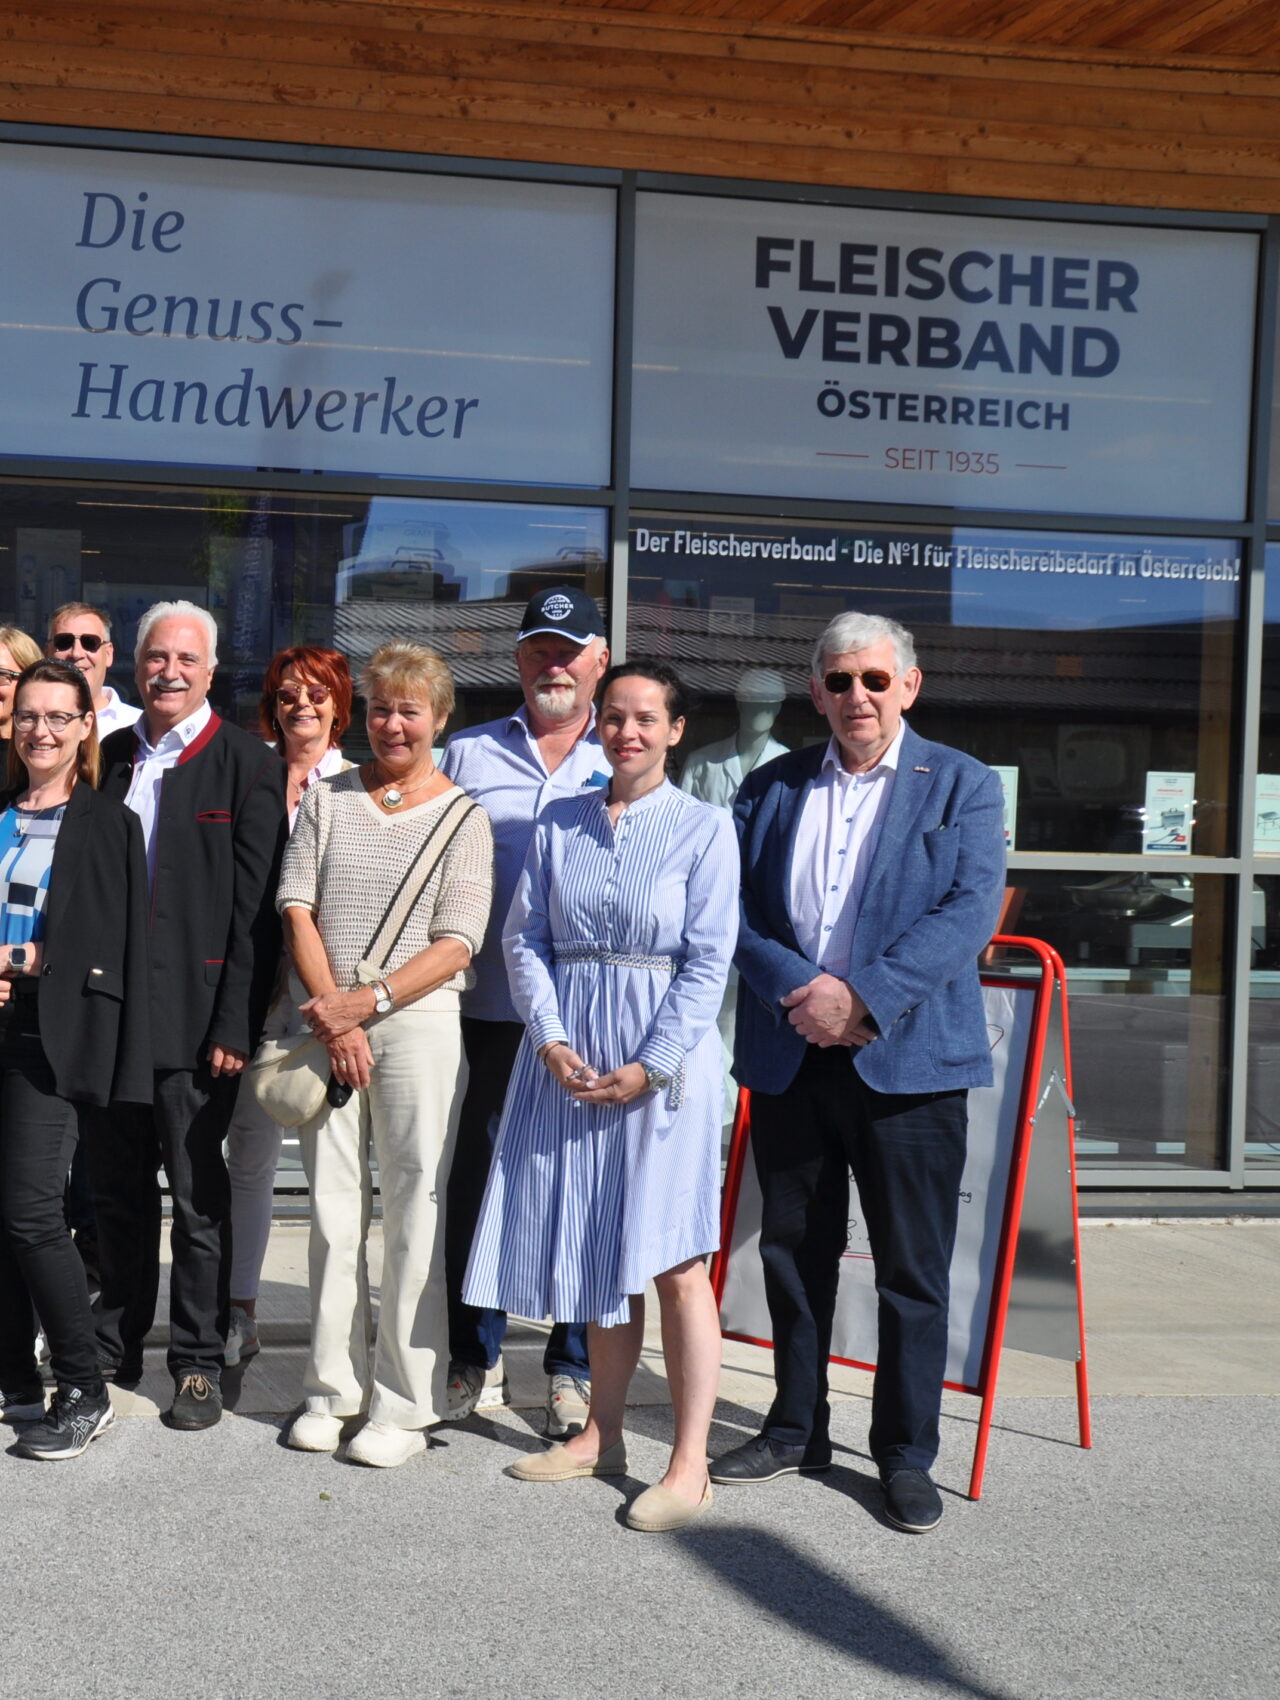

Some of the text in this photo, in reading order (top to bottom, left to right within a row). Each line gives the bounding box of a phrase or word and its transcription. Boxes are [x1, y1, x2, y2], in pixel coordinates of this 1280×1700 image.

[75, 191, 185, 253] Die
[755, 235, 1139, 313] FLEISCHER
[76, 277, 343, 345] Genuss-
[766, 306, 1121, 378] VERBAND
[71, 362, 480, 439] Handwerker
[816, 380, 1070, 431] ÖSTERREICH
[884, 447, 1000, 475] SEIT 1935
[636, 528, 669, 553] Der
[673, 531, 836, 561] Fleischerverband
[853, 540, 883, 564] Die
[924, 544, 952, 567] für
[957, 546, 1114, 575] Fleischereibedarf
[1119, 554, 1136, 577] in
[1141, 549, 1241, 581] Österreich!
